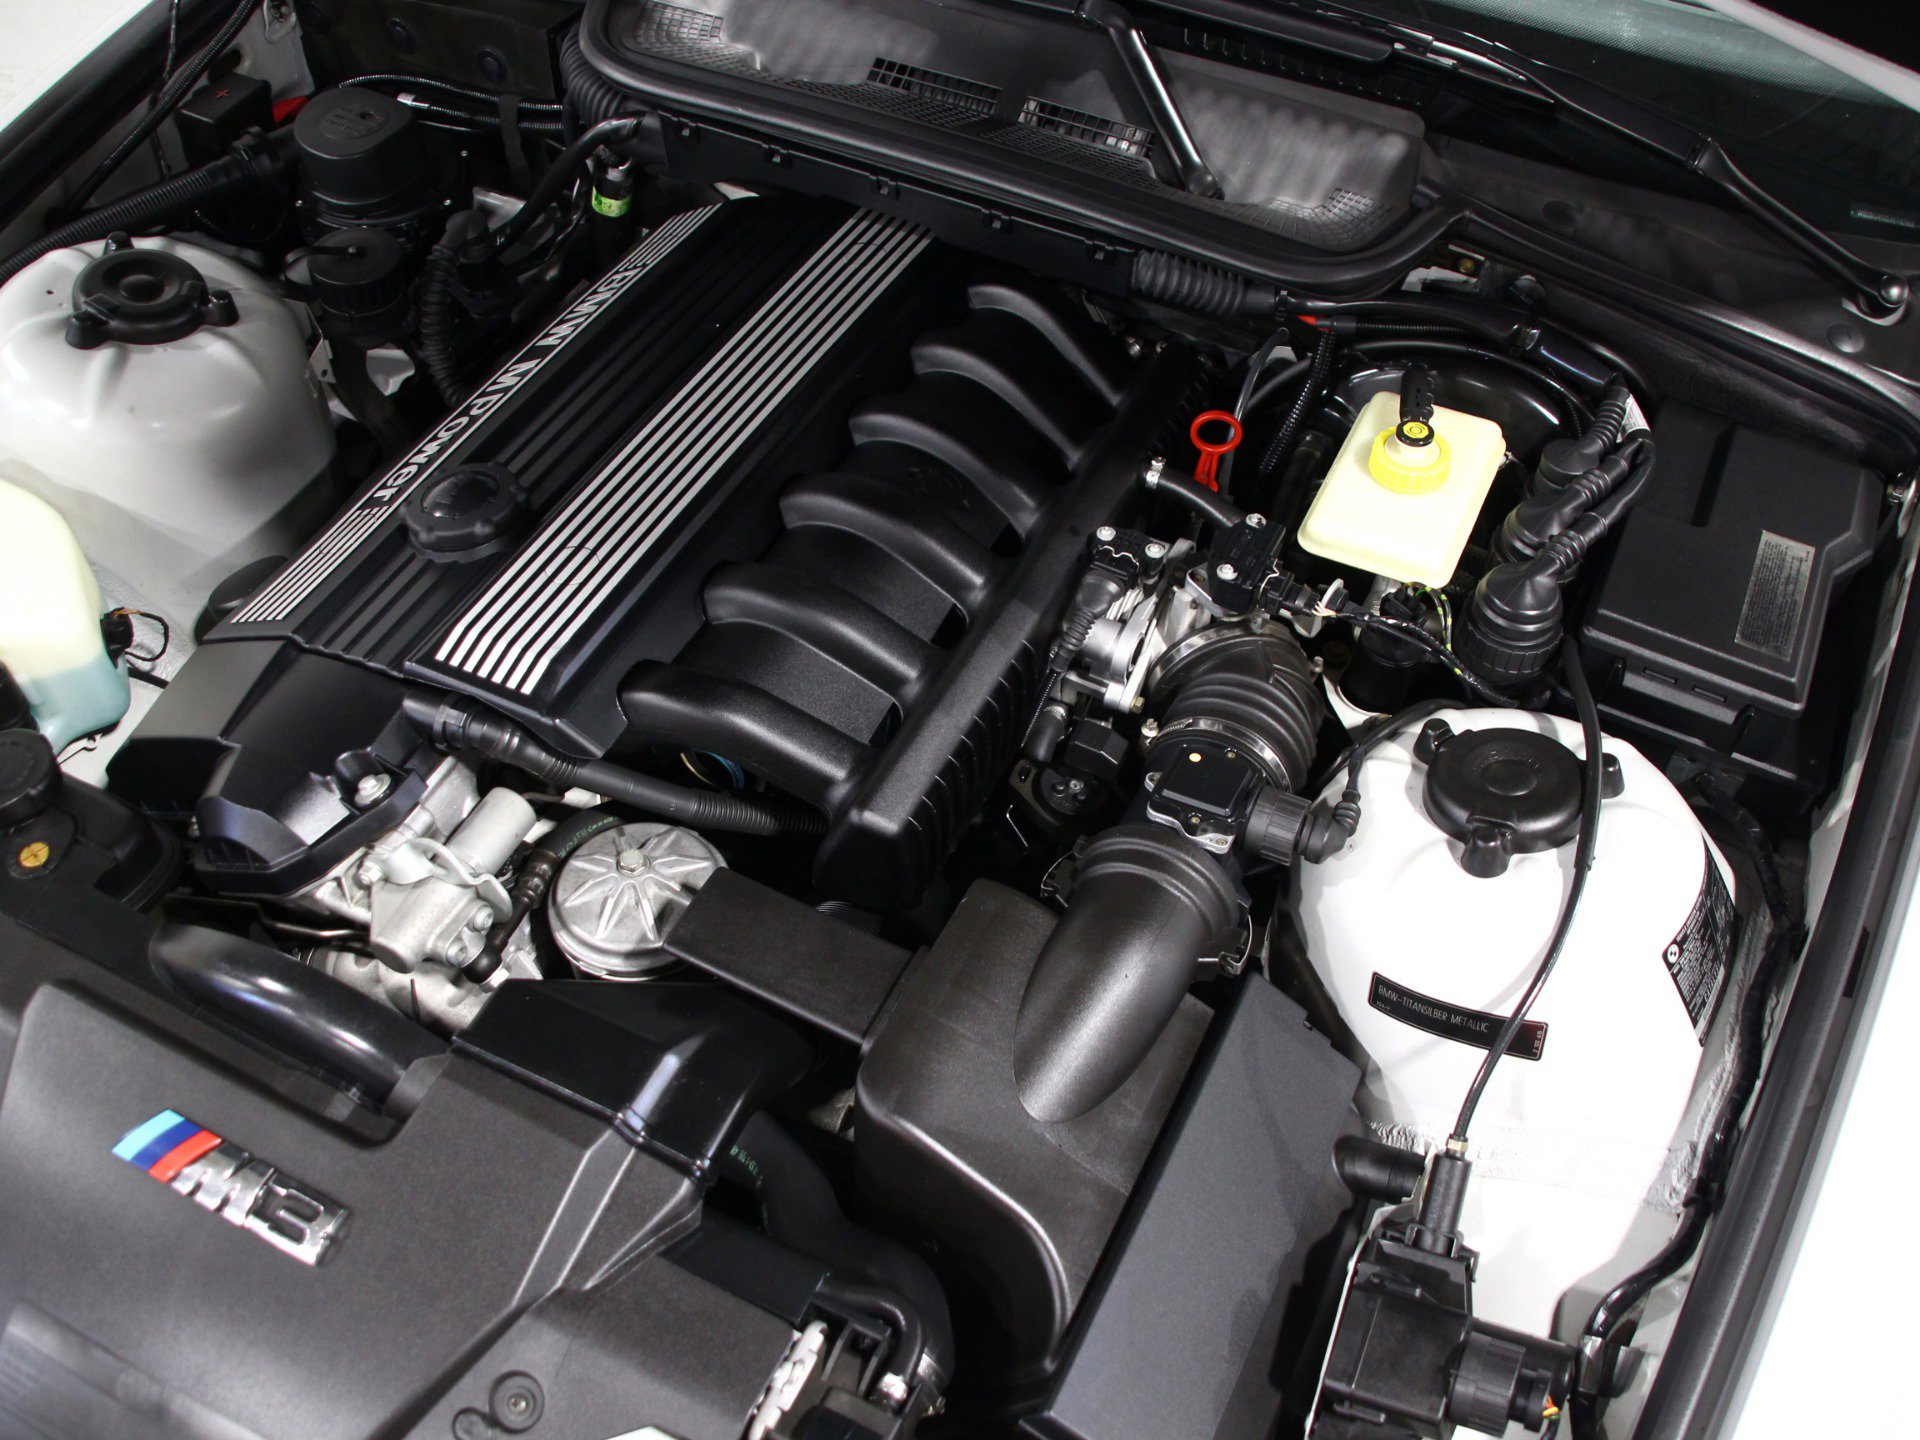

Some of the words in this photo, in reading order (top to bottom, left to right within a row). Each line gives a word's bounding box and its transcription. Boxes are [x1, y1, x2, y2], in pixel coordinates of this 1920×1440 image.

[535, 266, 643, 346] BMW
[1378, 984, 1448, 1021] BMW-TITANSILBER
[1450, 1014, 1490, 1032] METALLIC
[170, 1140, 351, 1266] M3
